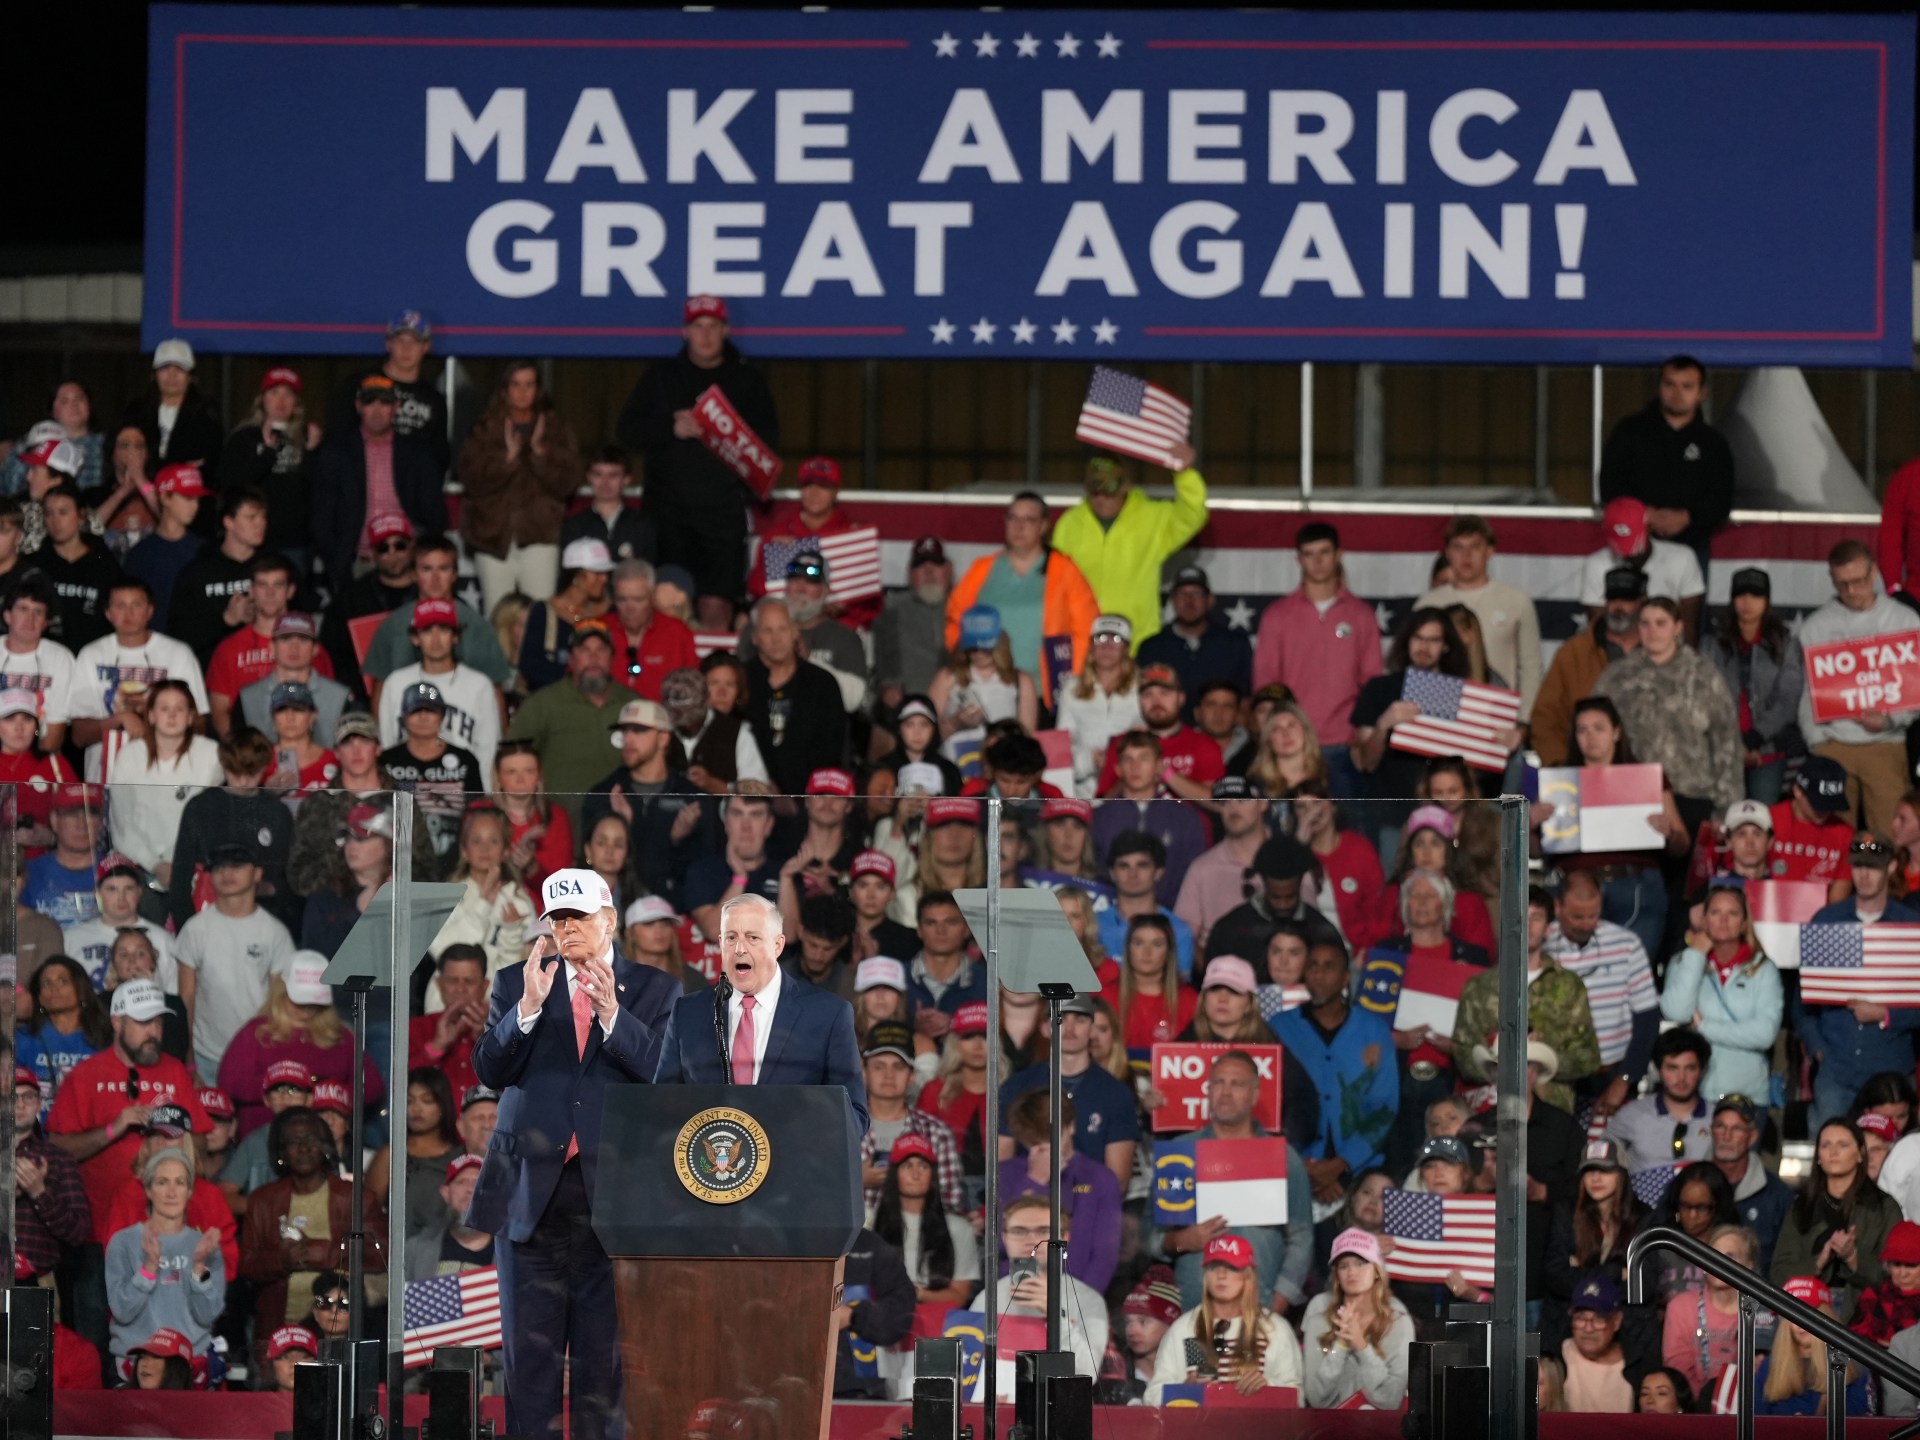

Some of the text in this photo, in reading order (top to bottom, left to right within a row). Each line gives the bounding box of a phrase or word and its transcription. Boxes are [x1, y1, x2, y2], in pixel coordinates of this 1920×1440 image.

[427, 88, 1636, 186] MAKE AMERICA
[466, 200, 1586, 299] GREAT AGAIN!
[702, 398, 774, 476] NO TAX
[1814, 641, 1918, 678] NO TAX
[1855, 671, 1881, 686] ON
[1840, 682, 1902, 711] TIPS
[1774, 842, 1841, 861] REEDOM
[548, 879, 584, 900] USA
[1160, 1055, 1205, 1080] NO
[97, 1081, 175, 1095] FREDOM
[314, 1084, 349, 1107] MAGA
[733, 1113, 746, 1124] THE
[1181, 1097, 1208, 1121] TI
[678, 1110, 721, 1153] PRESIDENT
[747, 1122, 767, 1162] UNITED
[678, 1156, 686, 1169] THE
[682, 1171, 690, 1180] OF
[730, 1169, 763, 1199] STATES
[1157, 1176, 1194, 1191] N C
[689, 1179, 714, 1199] SEAL
[1209, 1239, 1240, 1257] USA
